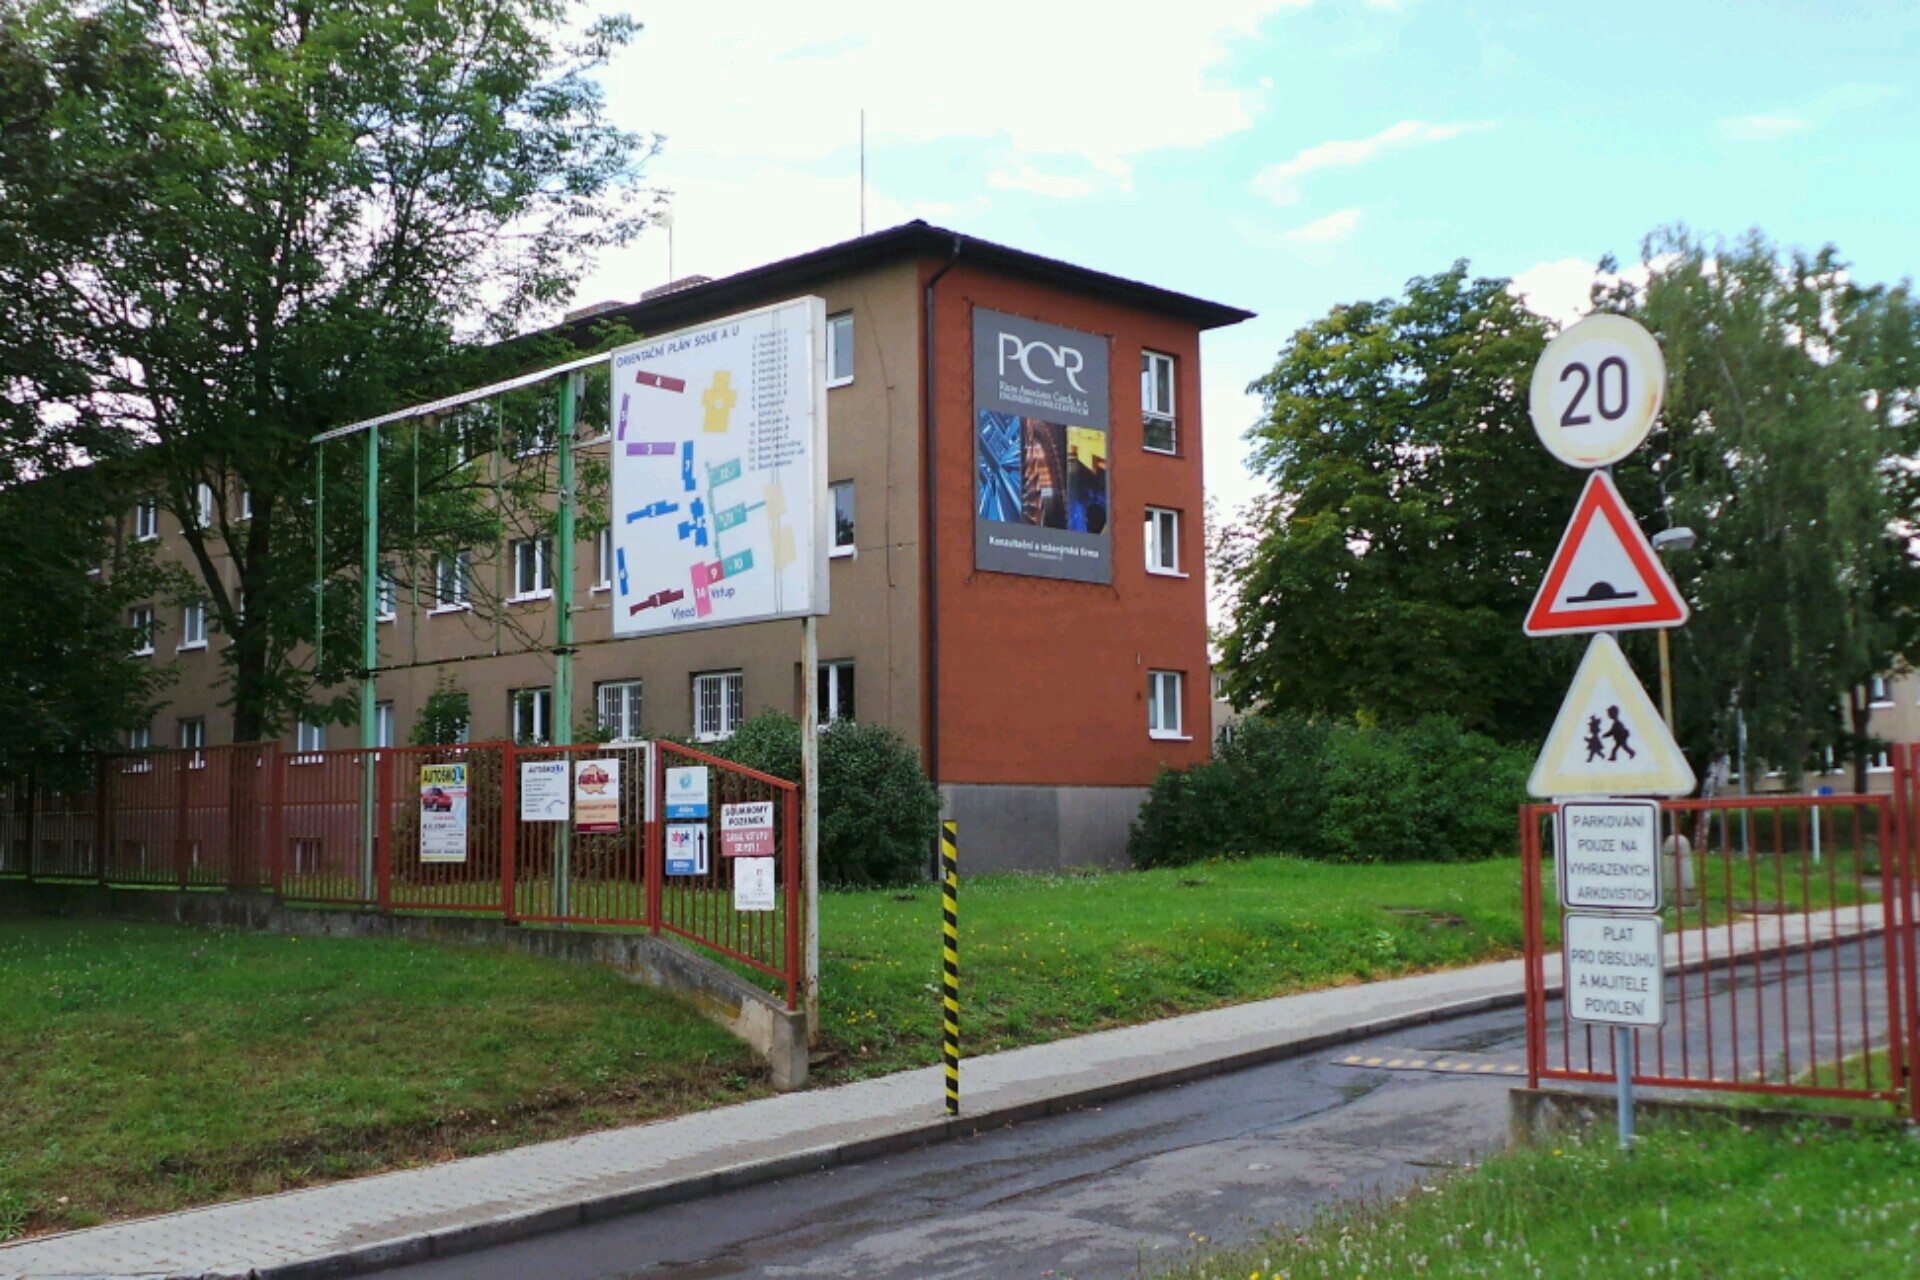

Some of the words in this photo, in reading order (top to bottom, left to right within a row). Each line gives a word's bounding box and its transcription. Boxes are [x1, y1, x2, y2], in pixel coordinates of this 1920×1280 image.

[1560, 356, 1628, 427] 20
[1578, 839, 1615, 851] POUZE
[1621, 839, 1638, 851] NA
[1572, 949, 1594, 965] PRO
[1598, 950, 1656, 968] OBSLUHU
[1579, 974, 1588, 987] A
[1591, 975, 1649, 992] MAJITELE
